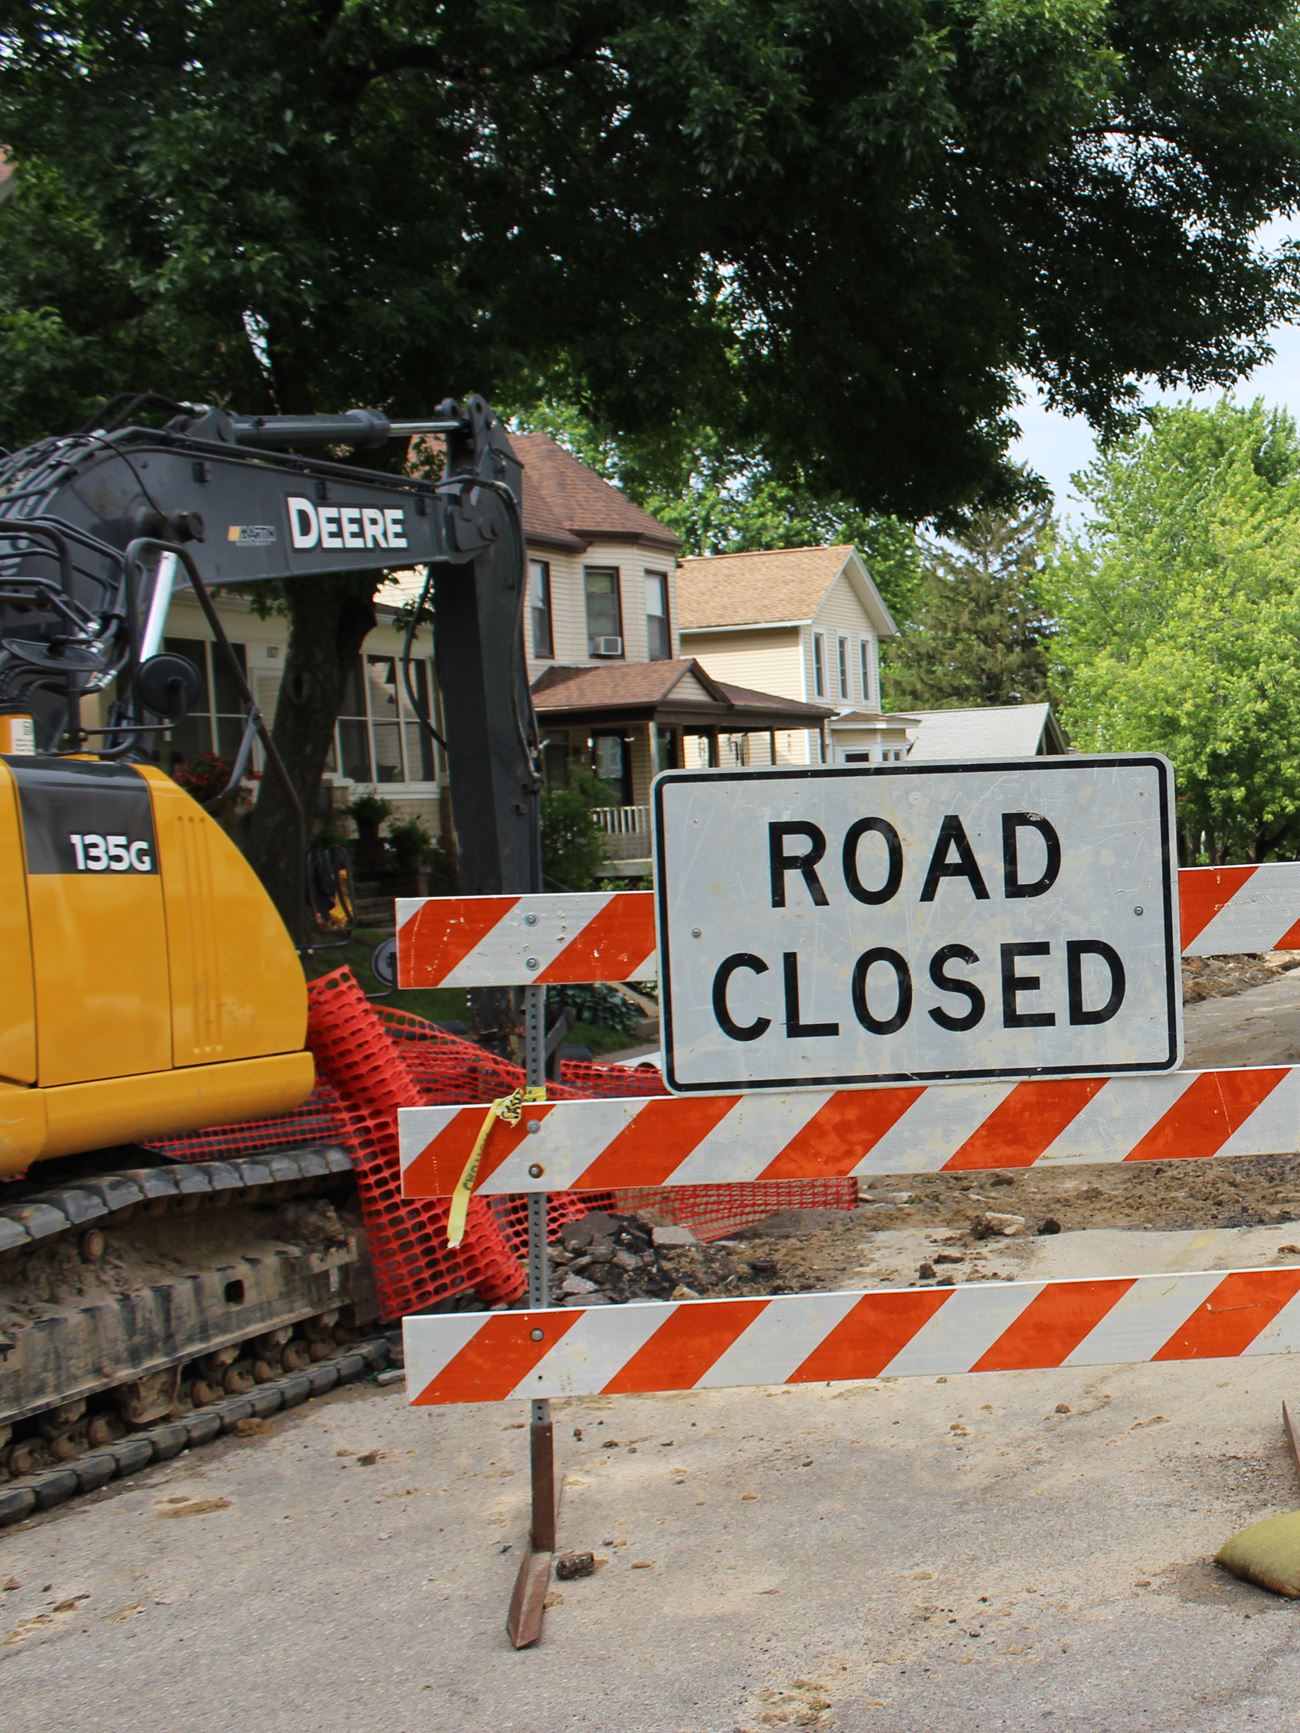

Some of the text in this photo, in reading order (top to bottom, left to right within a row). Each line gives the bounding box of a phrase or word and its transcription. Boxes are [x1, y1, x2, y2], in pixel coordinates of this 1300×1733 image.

[287, 497, 408, 548] DEERE
[70, 834, 152, 871] 135G
[768, 810, 1061, 908] ROAD
[712, 939, 1126, 1042] CLOSED
